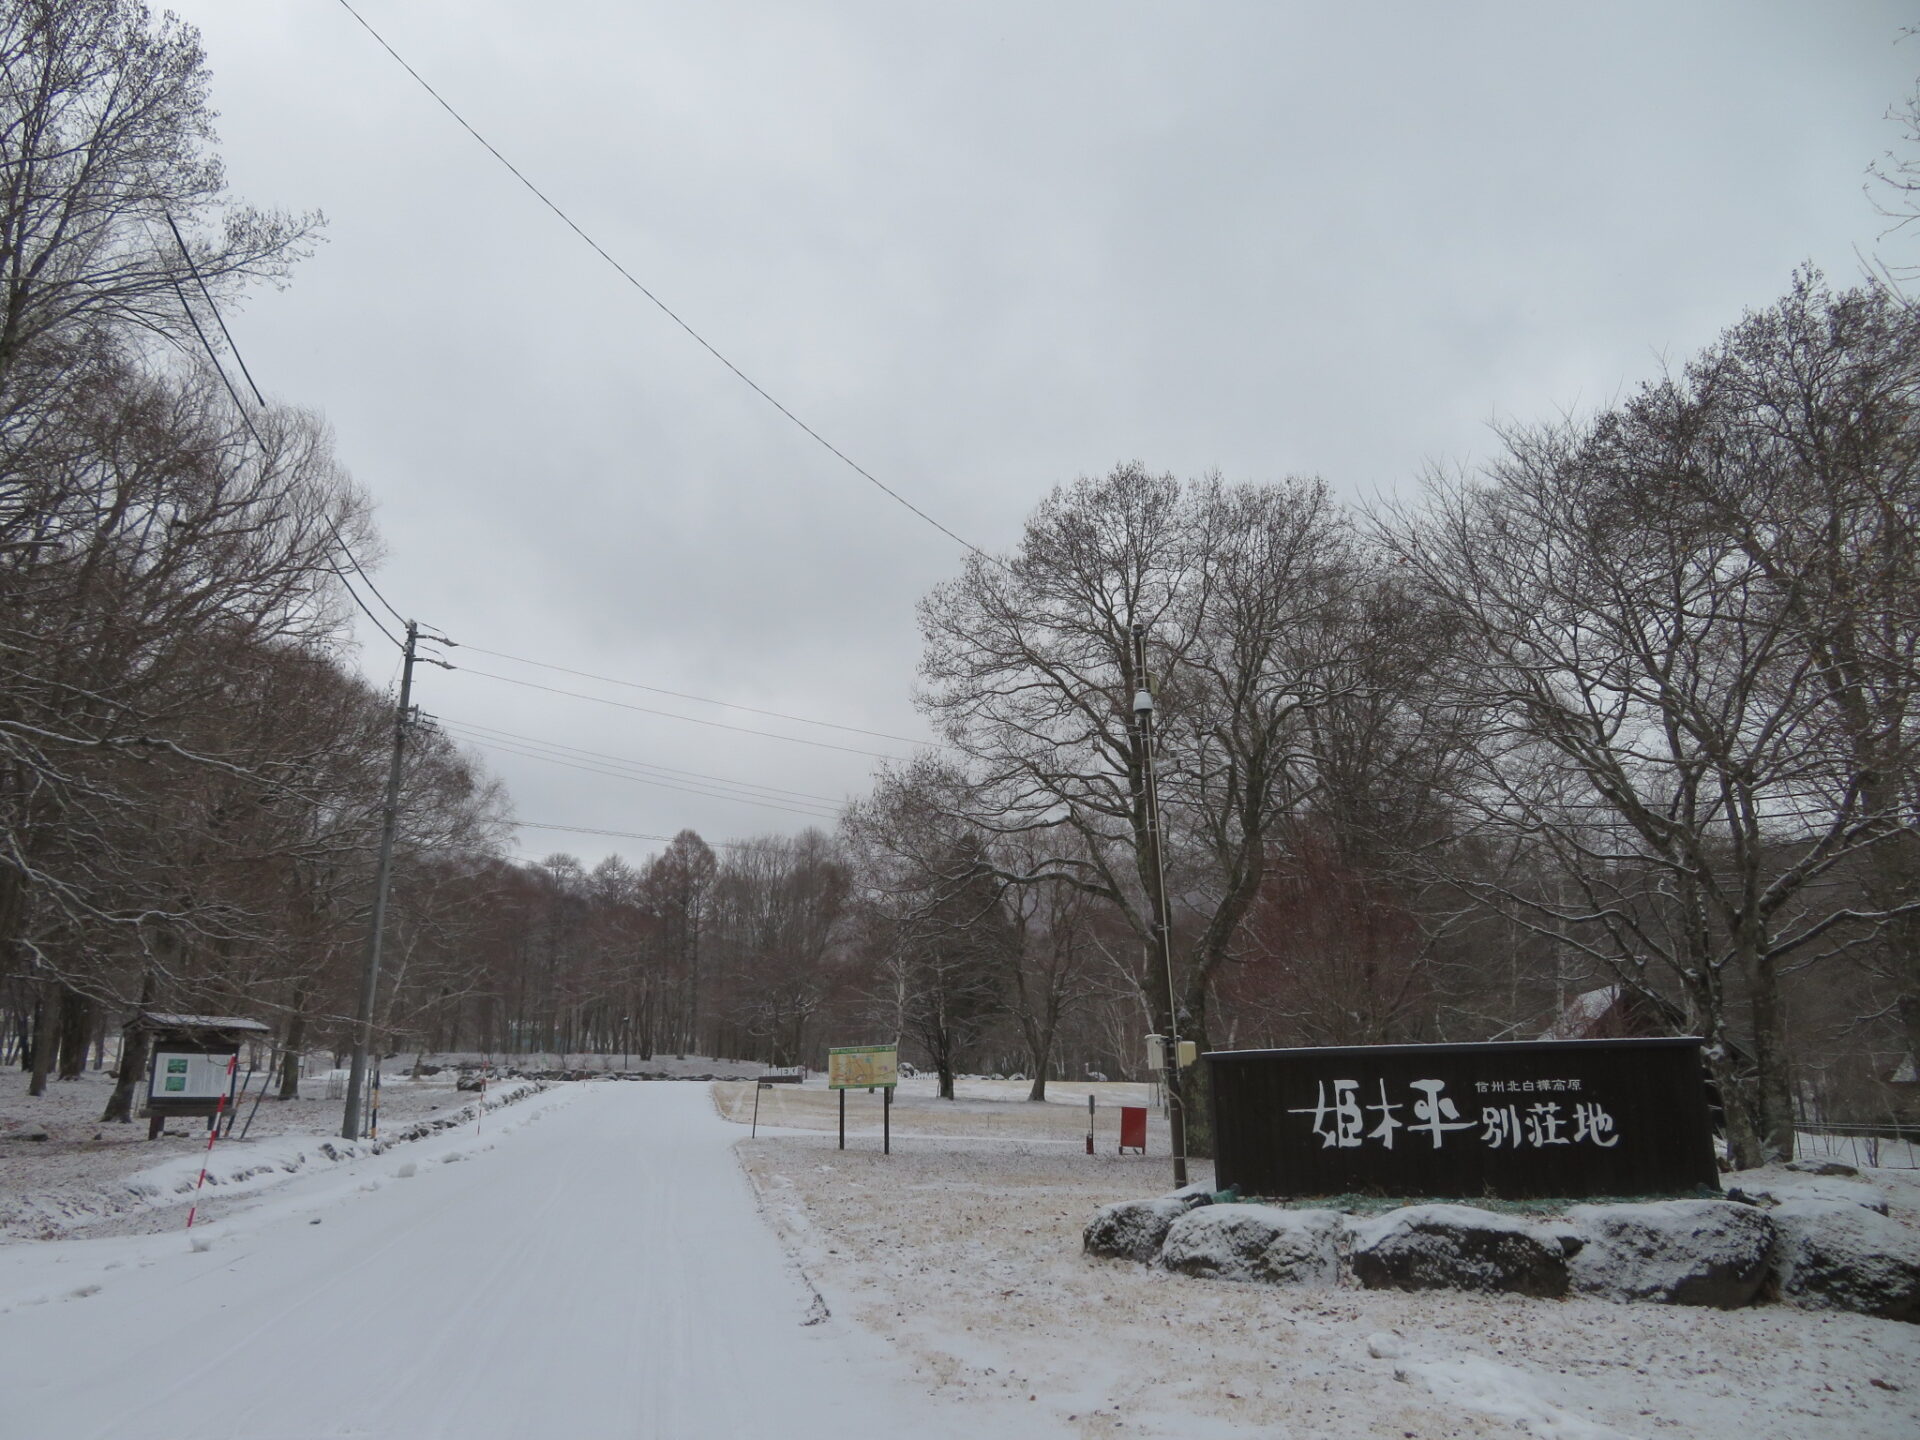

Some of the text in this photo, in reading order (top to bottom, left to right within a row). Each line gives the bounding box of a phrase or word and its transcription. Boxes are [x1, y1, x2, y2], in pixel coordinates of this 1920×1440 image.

[1475, 1079, 1582, 1093] 信州北白樺高原
[1288, 1078, 1619, 1149] 姫木平 別荘地
